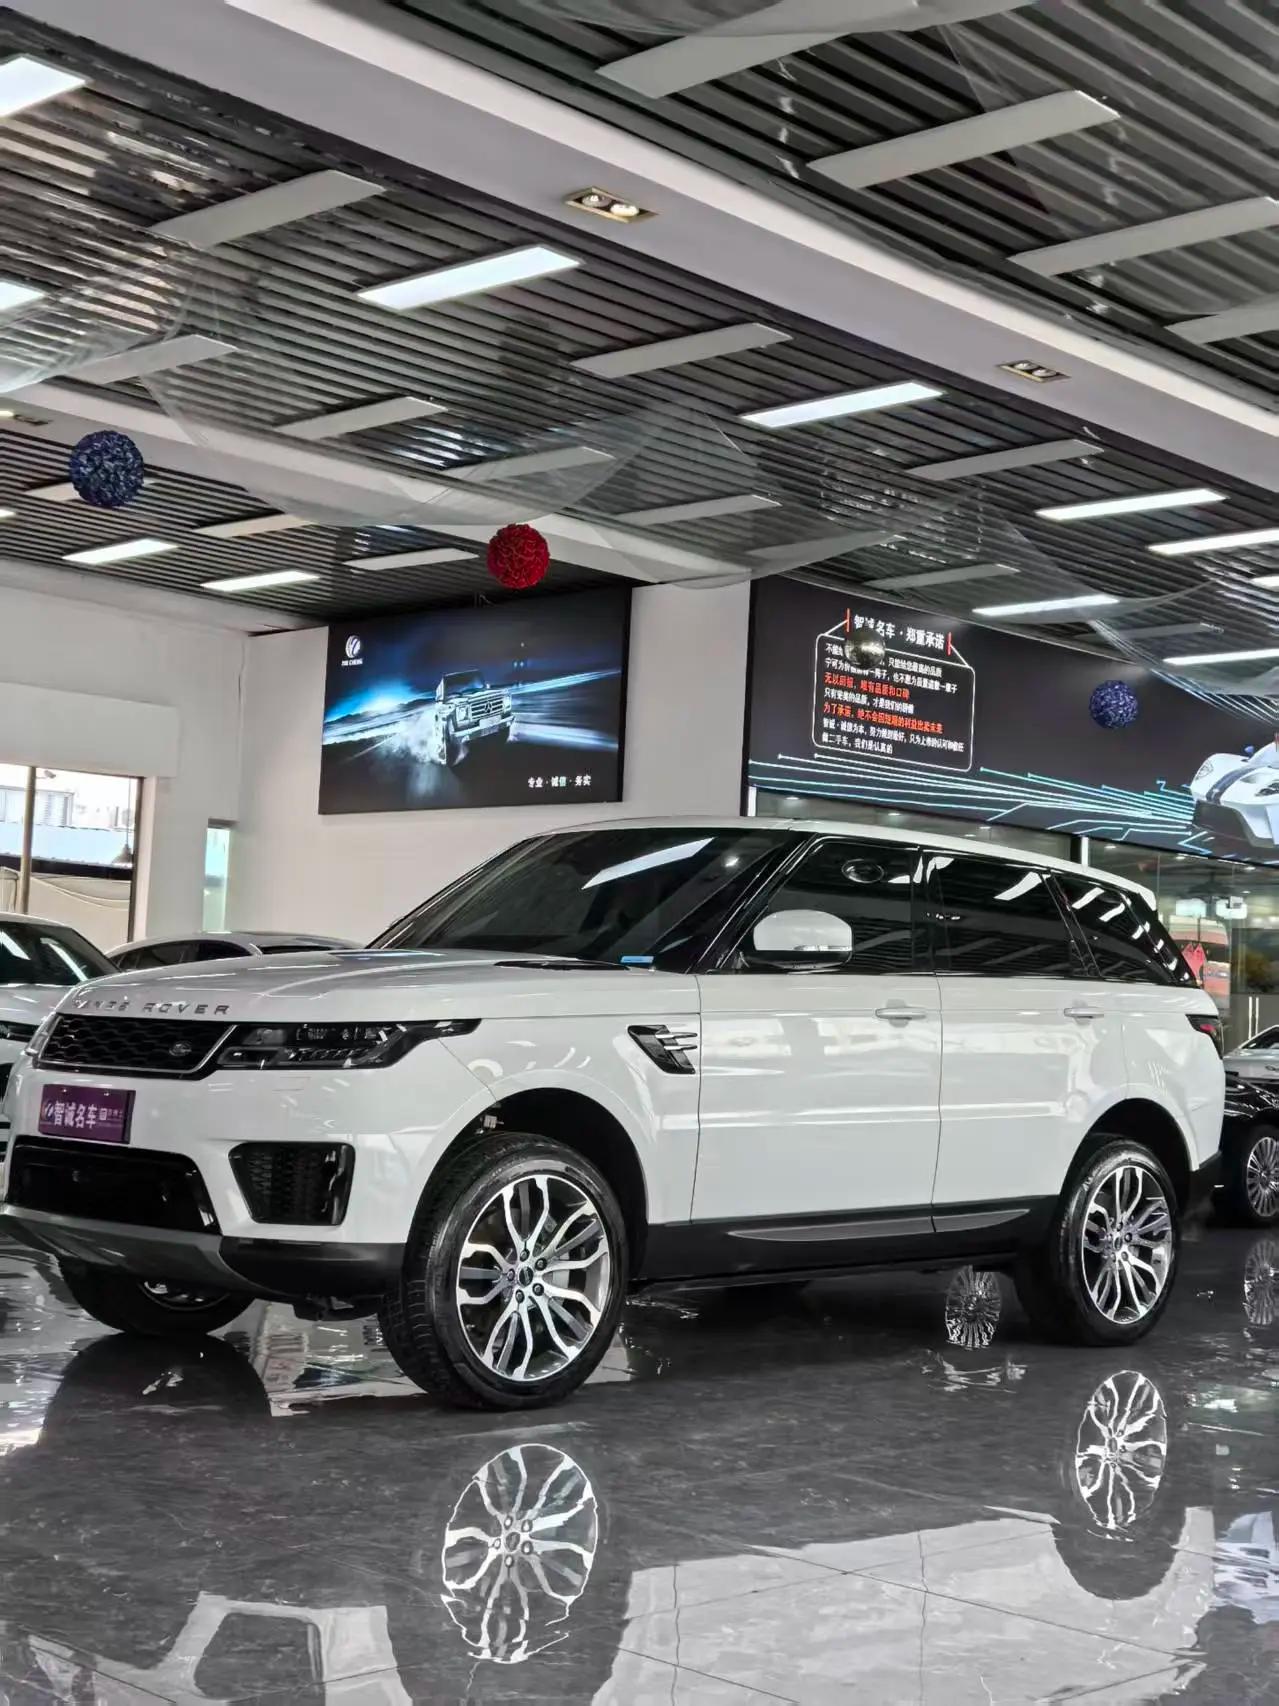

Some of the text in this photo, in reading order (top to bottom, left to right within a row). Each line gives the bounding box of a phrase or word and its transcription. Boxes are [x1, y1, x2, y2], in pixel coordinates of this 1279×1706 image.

[142, 1002, 230, 1016] ROVER
[54, 1100, 98, 1129] 智诚名车
